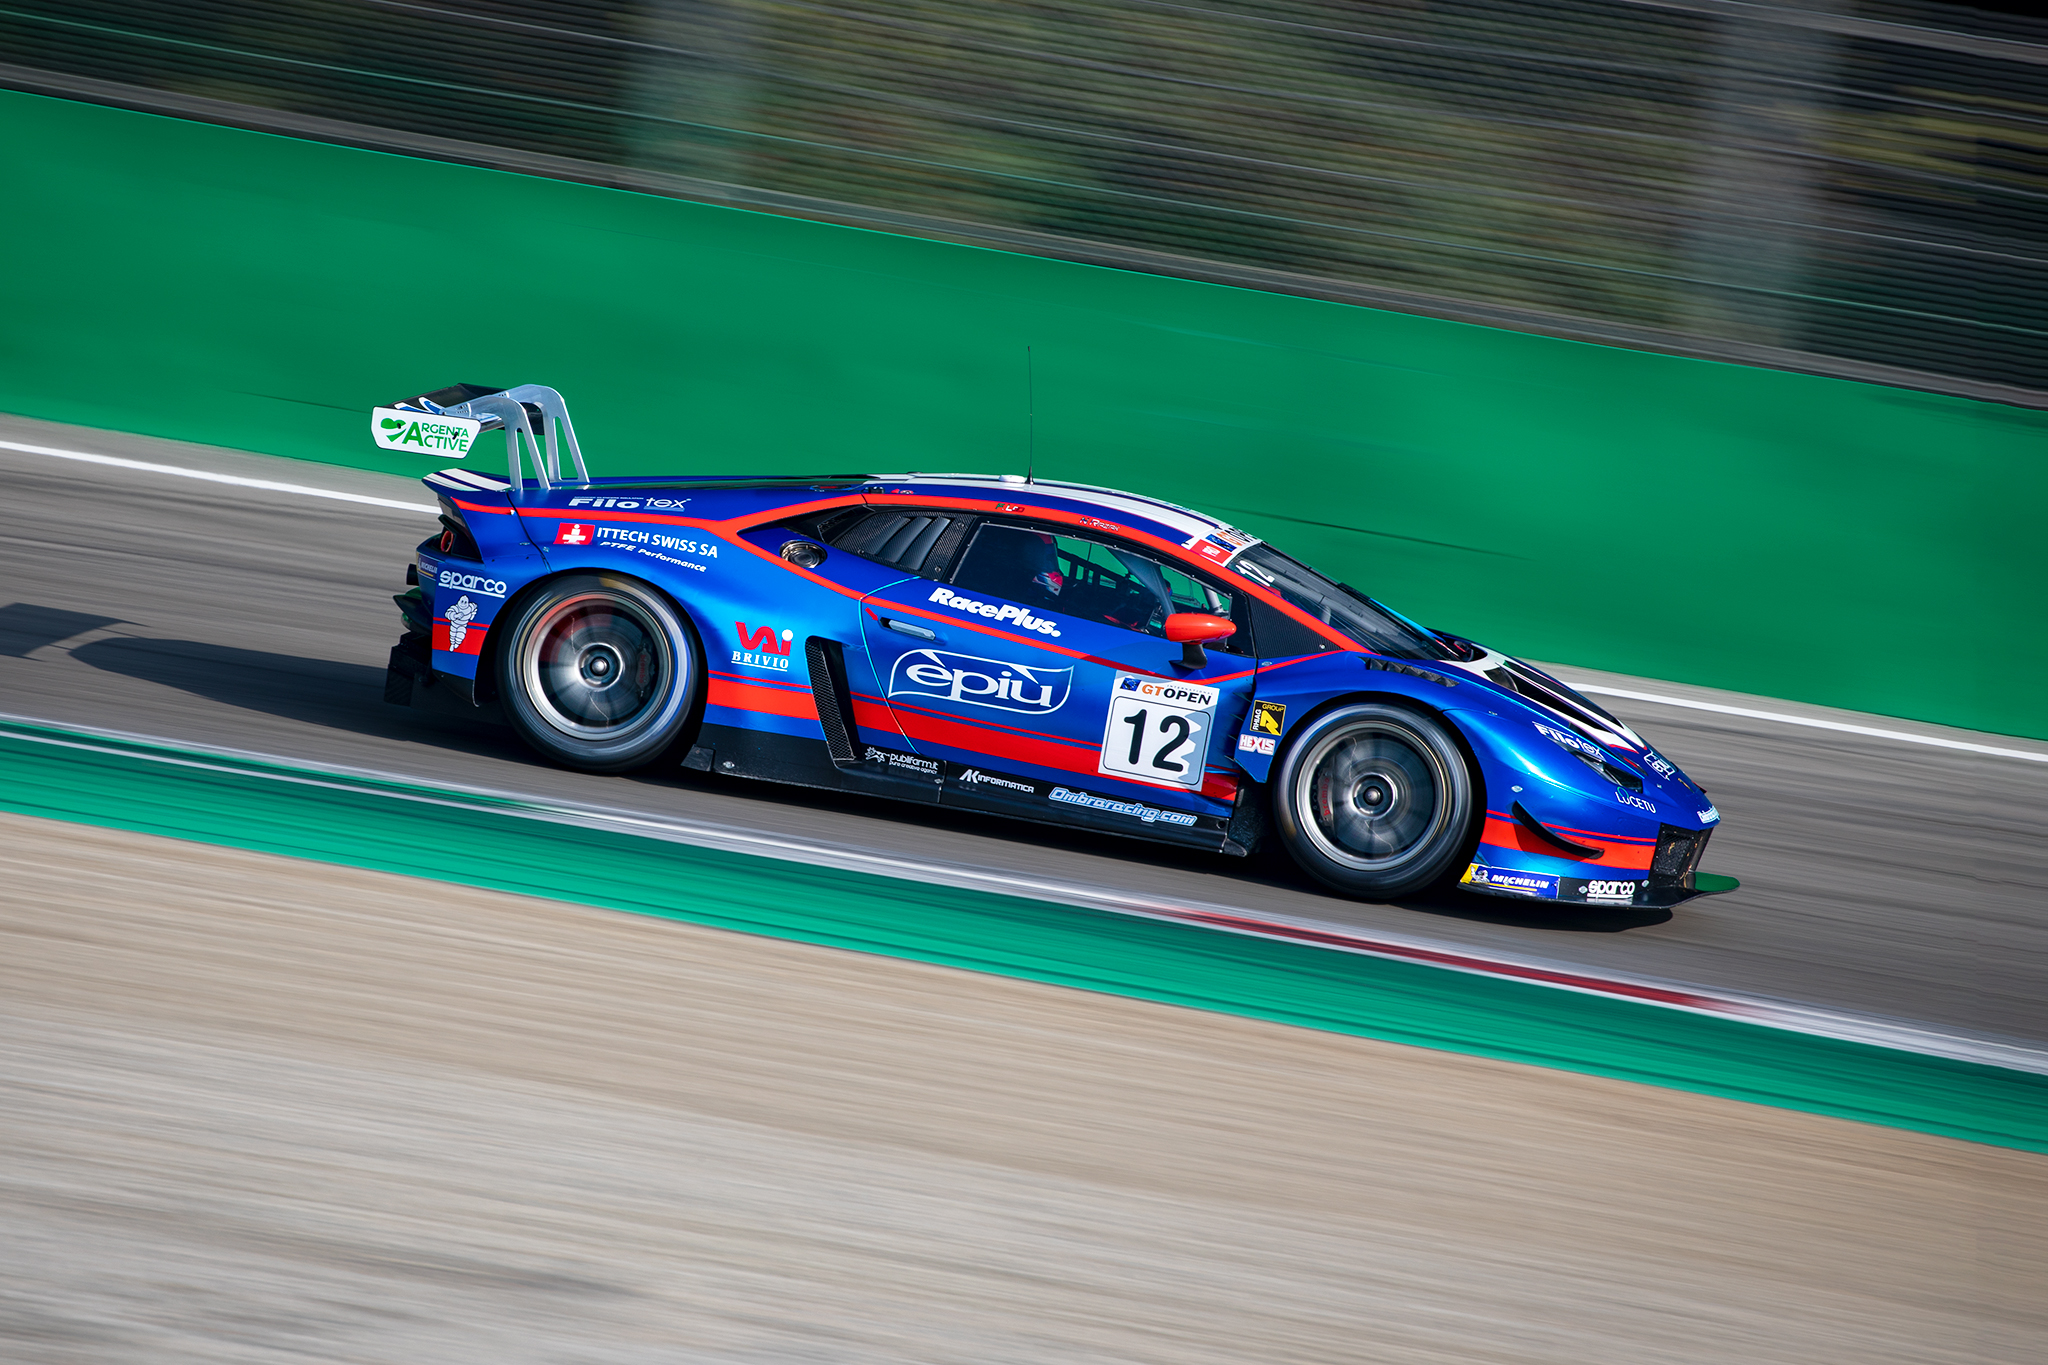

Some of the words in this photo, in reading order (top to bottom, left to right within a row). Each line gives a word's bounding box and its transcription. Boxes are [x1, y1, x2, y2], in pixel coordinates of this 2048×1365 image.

[597, 527, 650, 544] ITTECH
[651, 534, 697, 554] SWISS
[698, 543, 718, 558] SA
[600, 541, 636, 552] PTFE
[638, 548, 707, 573] Performance
[439, 570, 507, 594] sparco
[928, 587, 1062, 638] RacePlus.
[732, 651, 789, 669] BRIVIO
[1262, 703, 1284, 712] GROUP
[1123, 708, 1191, 773] 12
[1239, 734, 1276, 755] HEXIS
[1049, 787, 1198, 827] Ombraracing.com
[1491, 874, 1550, 889] MICHELIN
[1588, 880, 1636, 897] sparco
